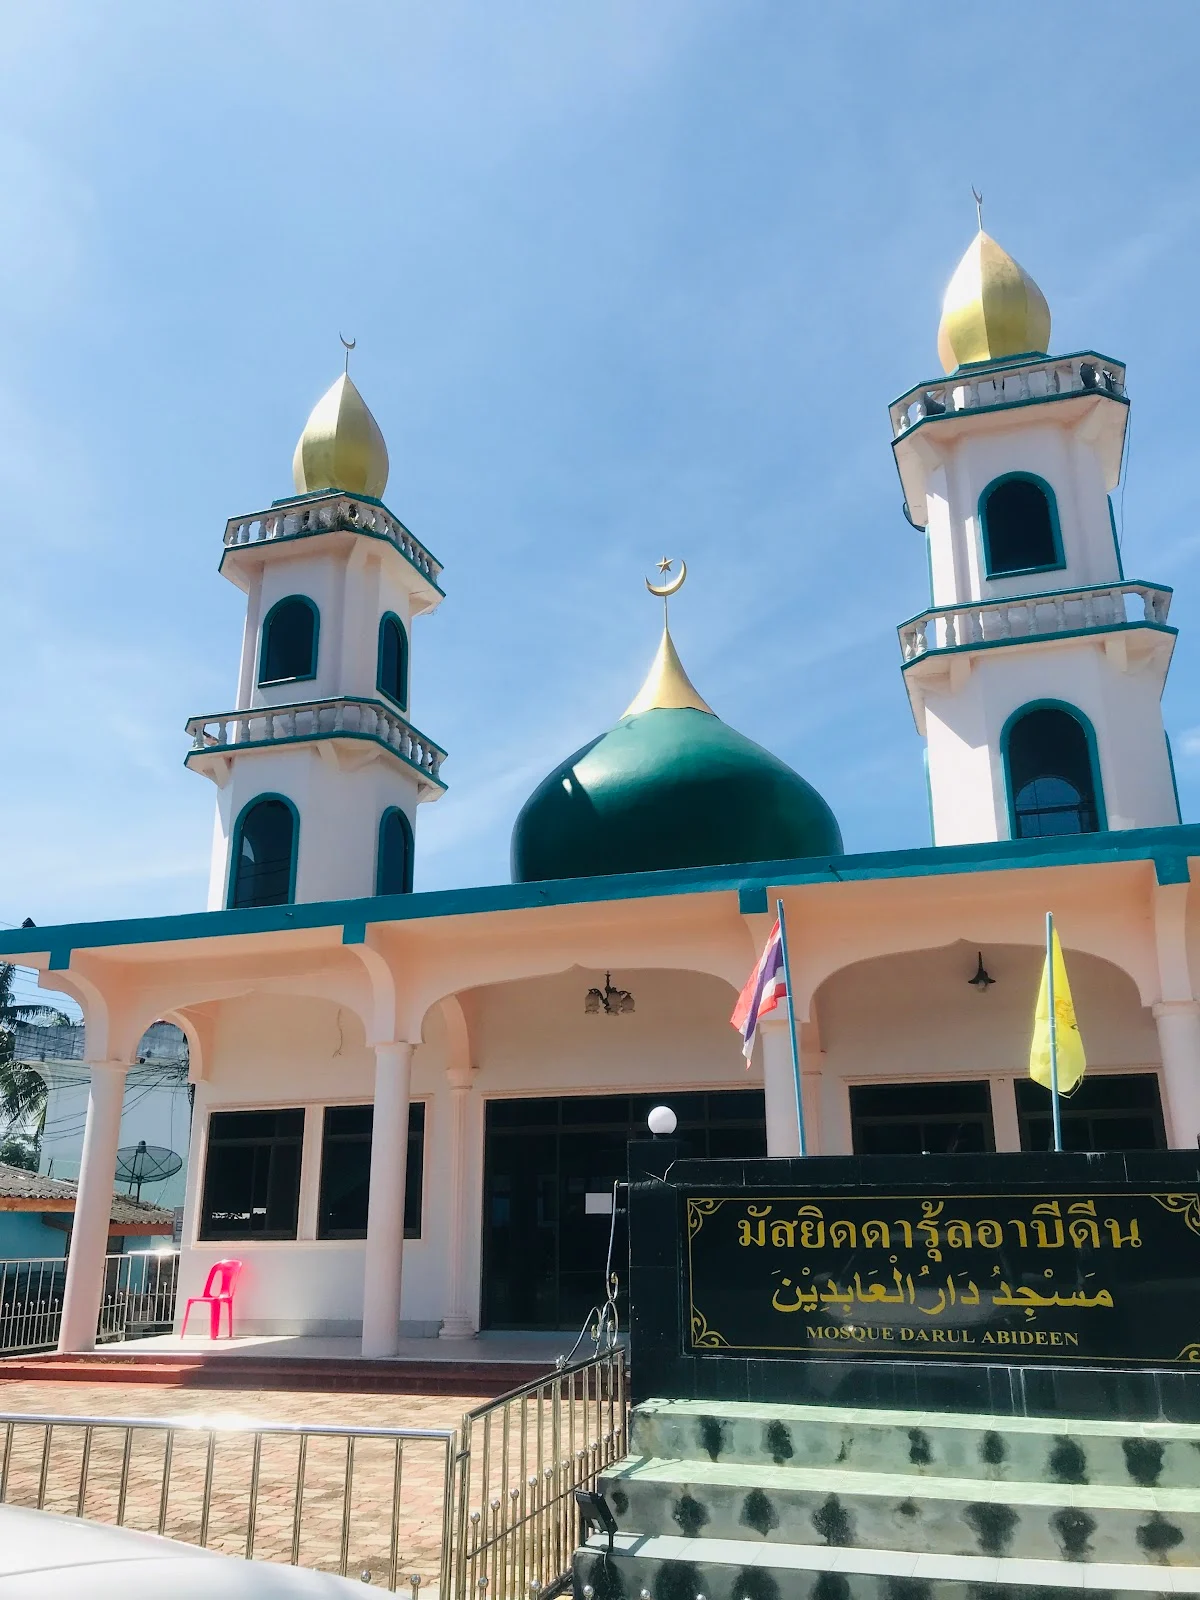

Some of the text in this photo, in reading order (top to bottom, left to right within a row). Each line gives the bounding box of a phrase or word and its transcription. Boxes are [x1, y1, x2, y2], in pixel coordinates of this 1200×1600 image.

[737, 1200, 1142, 1262] มัสยิดดารุ้ลอาบีดีน
[806, 1325, 1080, 1347] MOSQUE DARUL ABIDEEN
